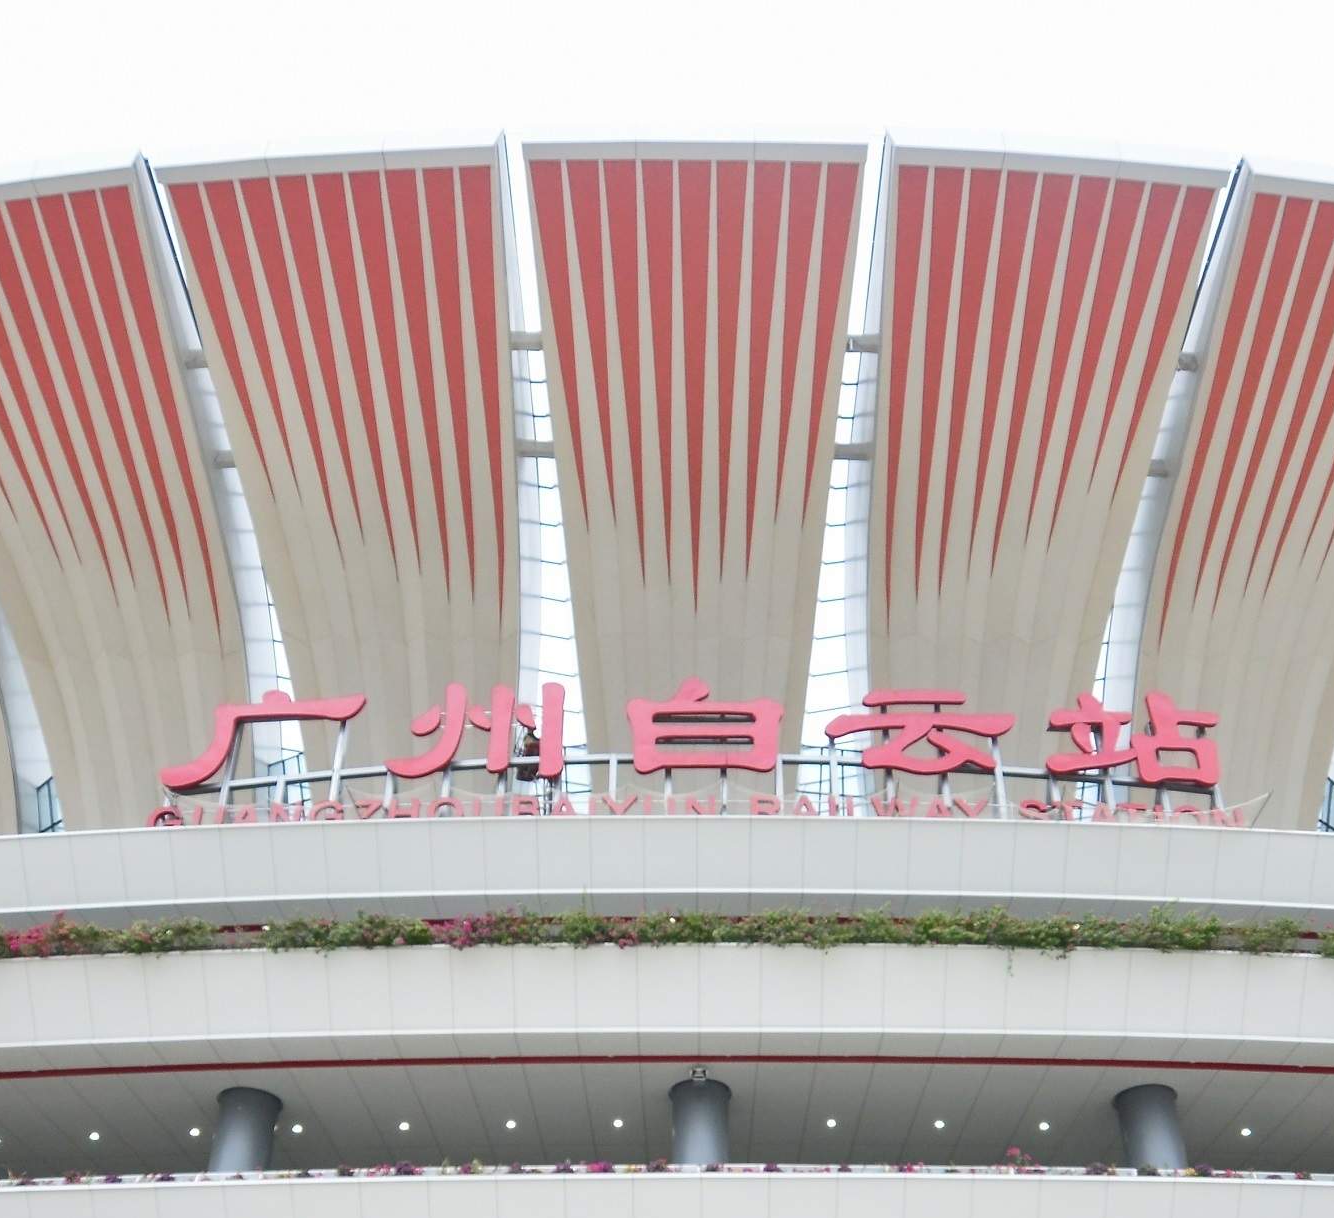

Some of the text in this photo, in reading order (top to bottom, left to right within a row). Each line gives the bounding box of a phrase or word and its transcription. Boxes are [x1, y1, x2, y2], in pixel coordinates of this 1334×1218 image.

[160, 677, 1218, 788] 广州白云站
